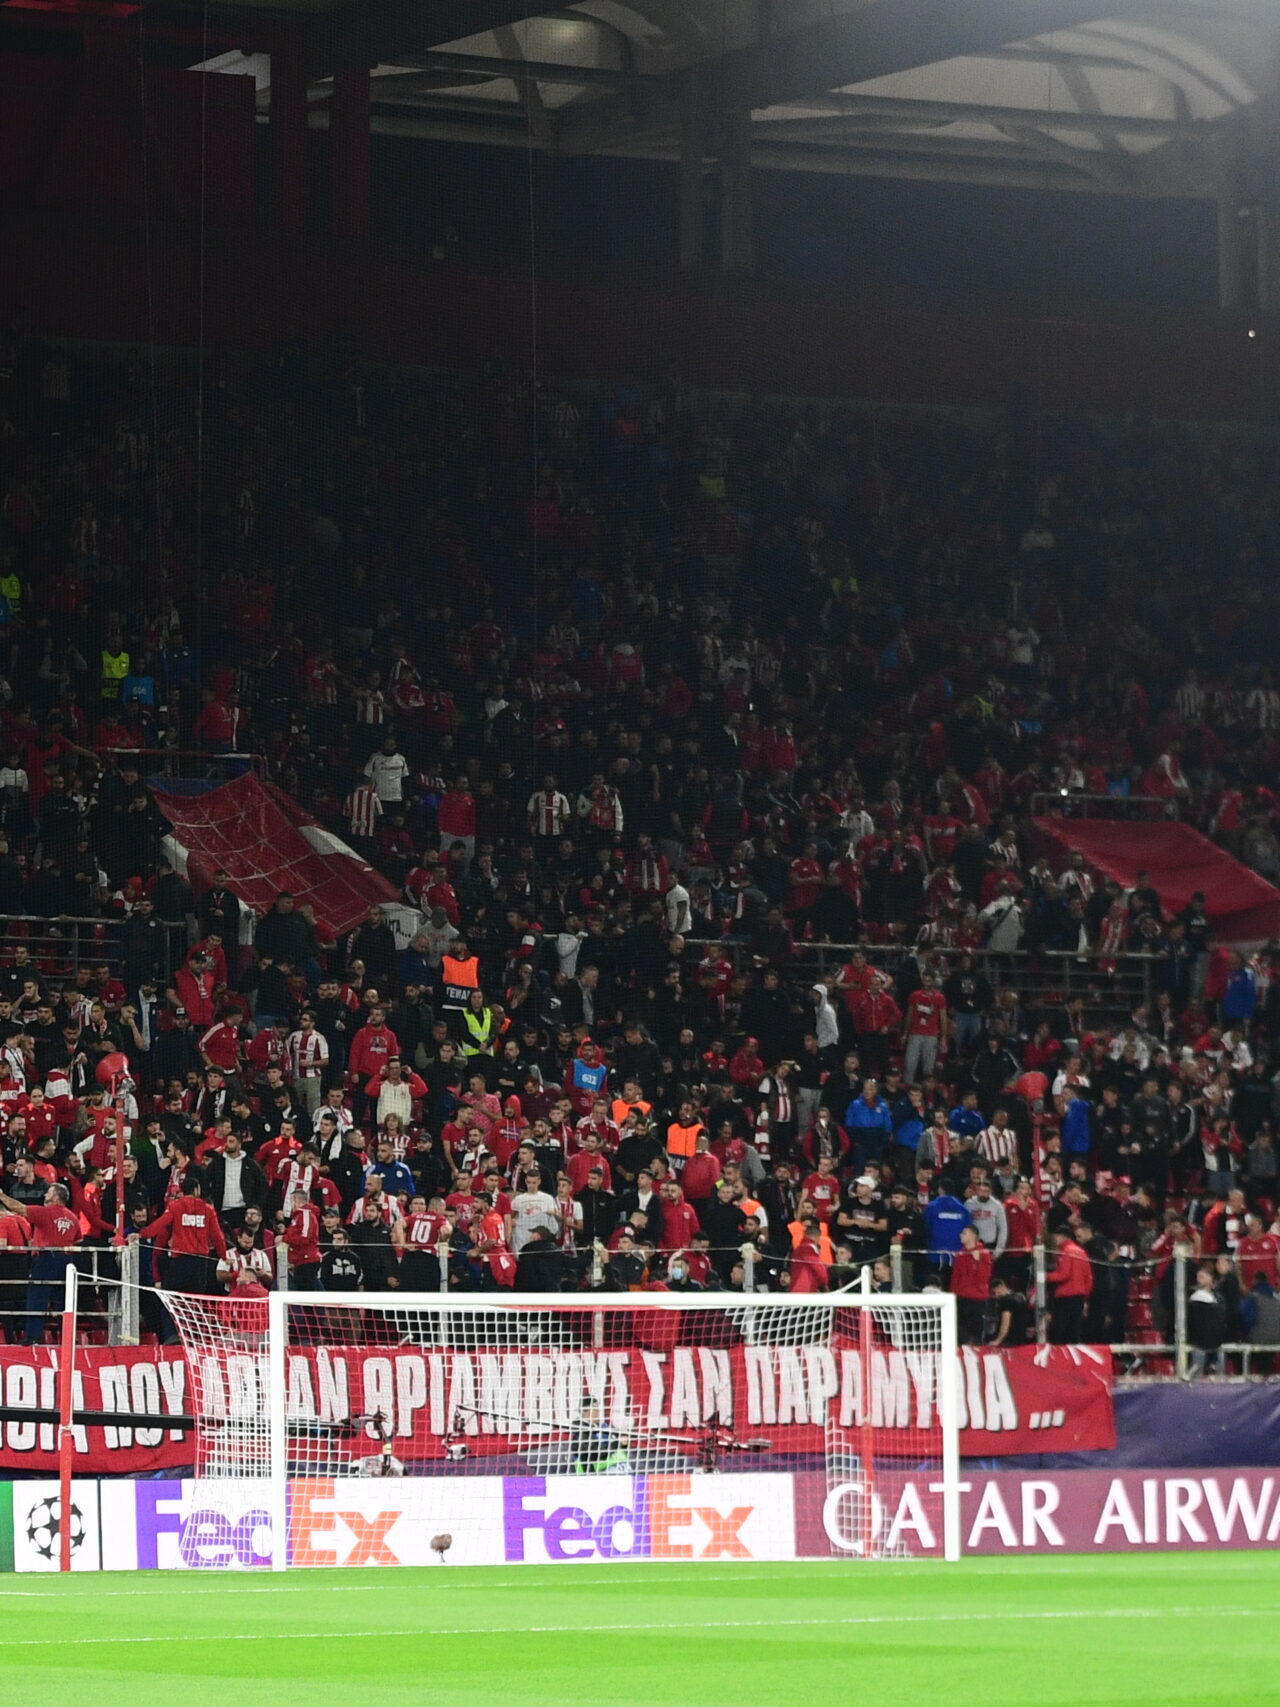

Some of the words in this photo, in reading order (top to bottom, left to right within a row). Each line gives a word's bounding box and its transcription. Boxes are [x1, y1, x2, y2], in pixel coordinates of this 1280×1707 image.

[411, 1219, 432, 1243] 10
[99, 1360, 184, 1449] ΠΟΥ
[643, 1347, 733, 1429] ΣΑΝ
[135, 1477, 403, 1569] FedEx
[502, 1473, 755, 1561] FedEx
